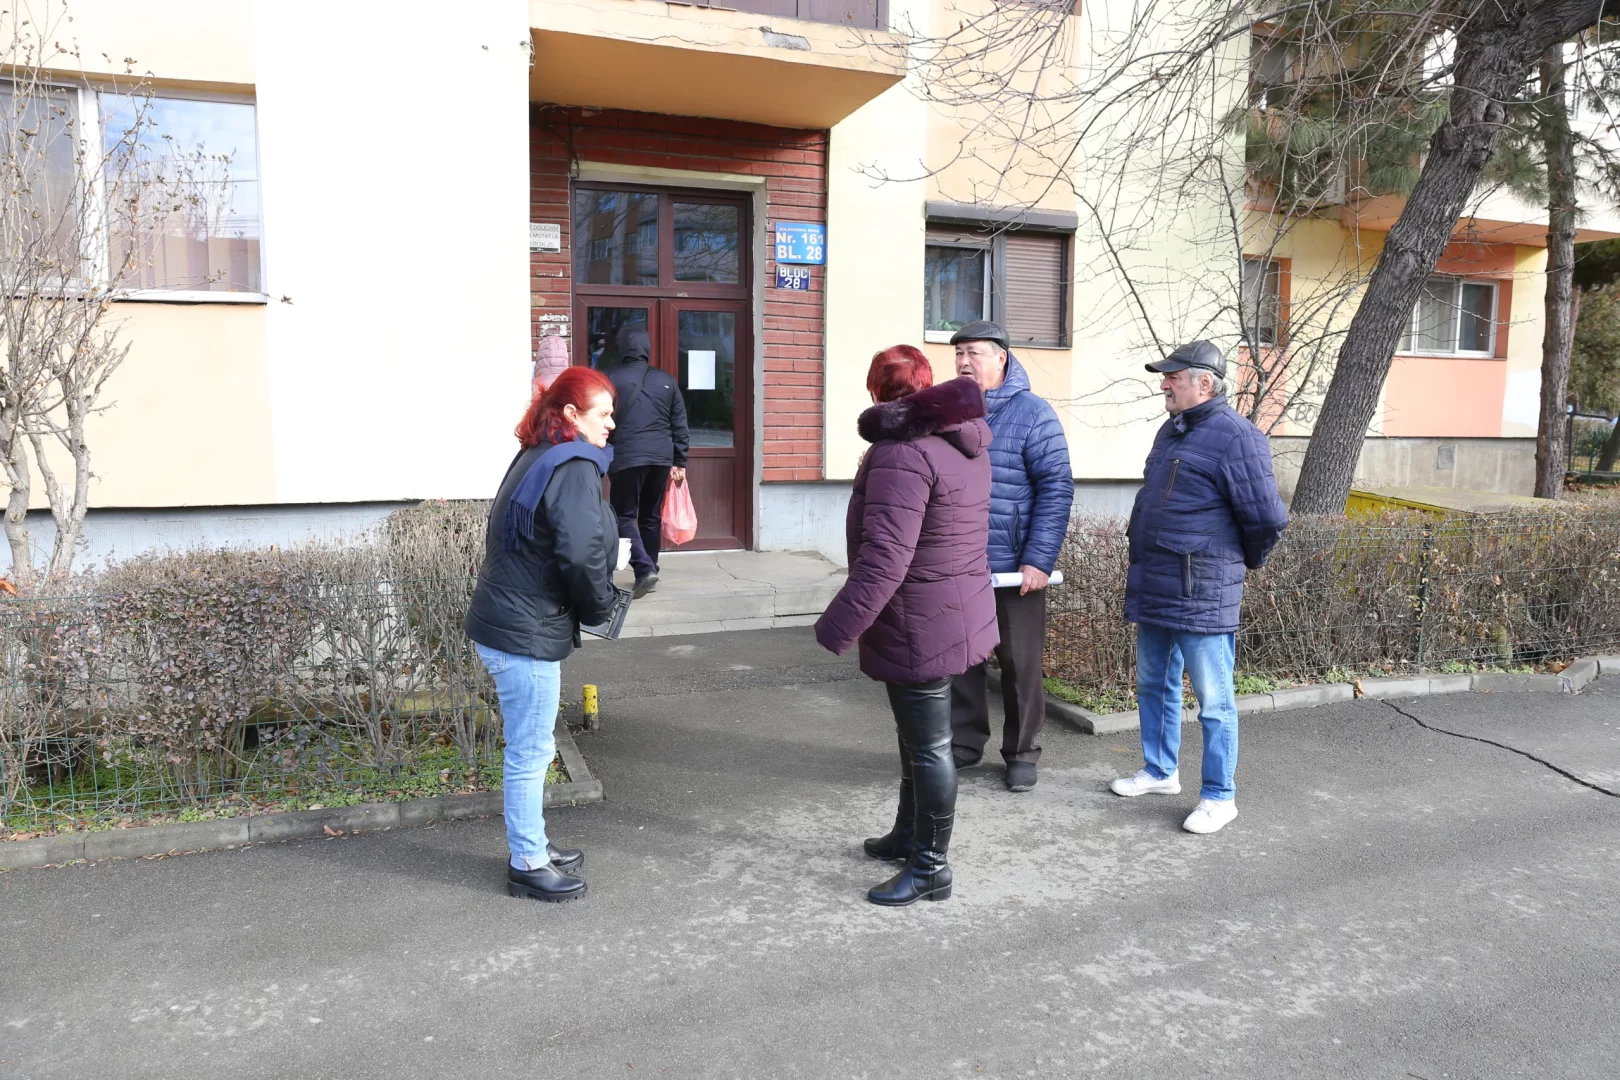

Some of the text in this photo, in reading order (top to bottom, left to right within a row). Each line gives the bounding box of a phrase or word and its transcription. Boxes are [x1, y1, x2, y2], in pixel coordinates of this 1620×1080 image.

[776, 232, 824, 245] Nr. 161
[777, 245, 823, 261] BL. 28
[780, 266, 807, 278] BLOC
[784, 277, 801, 289] 28
